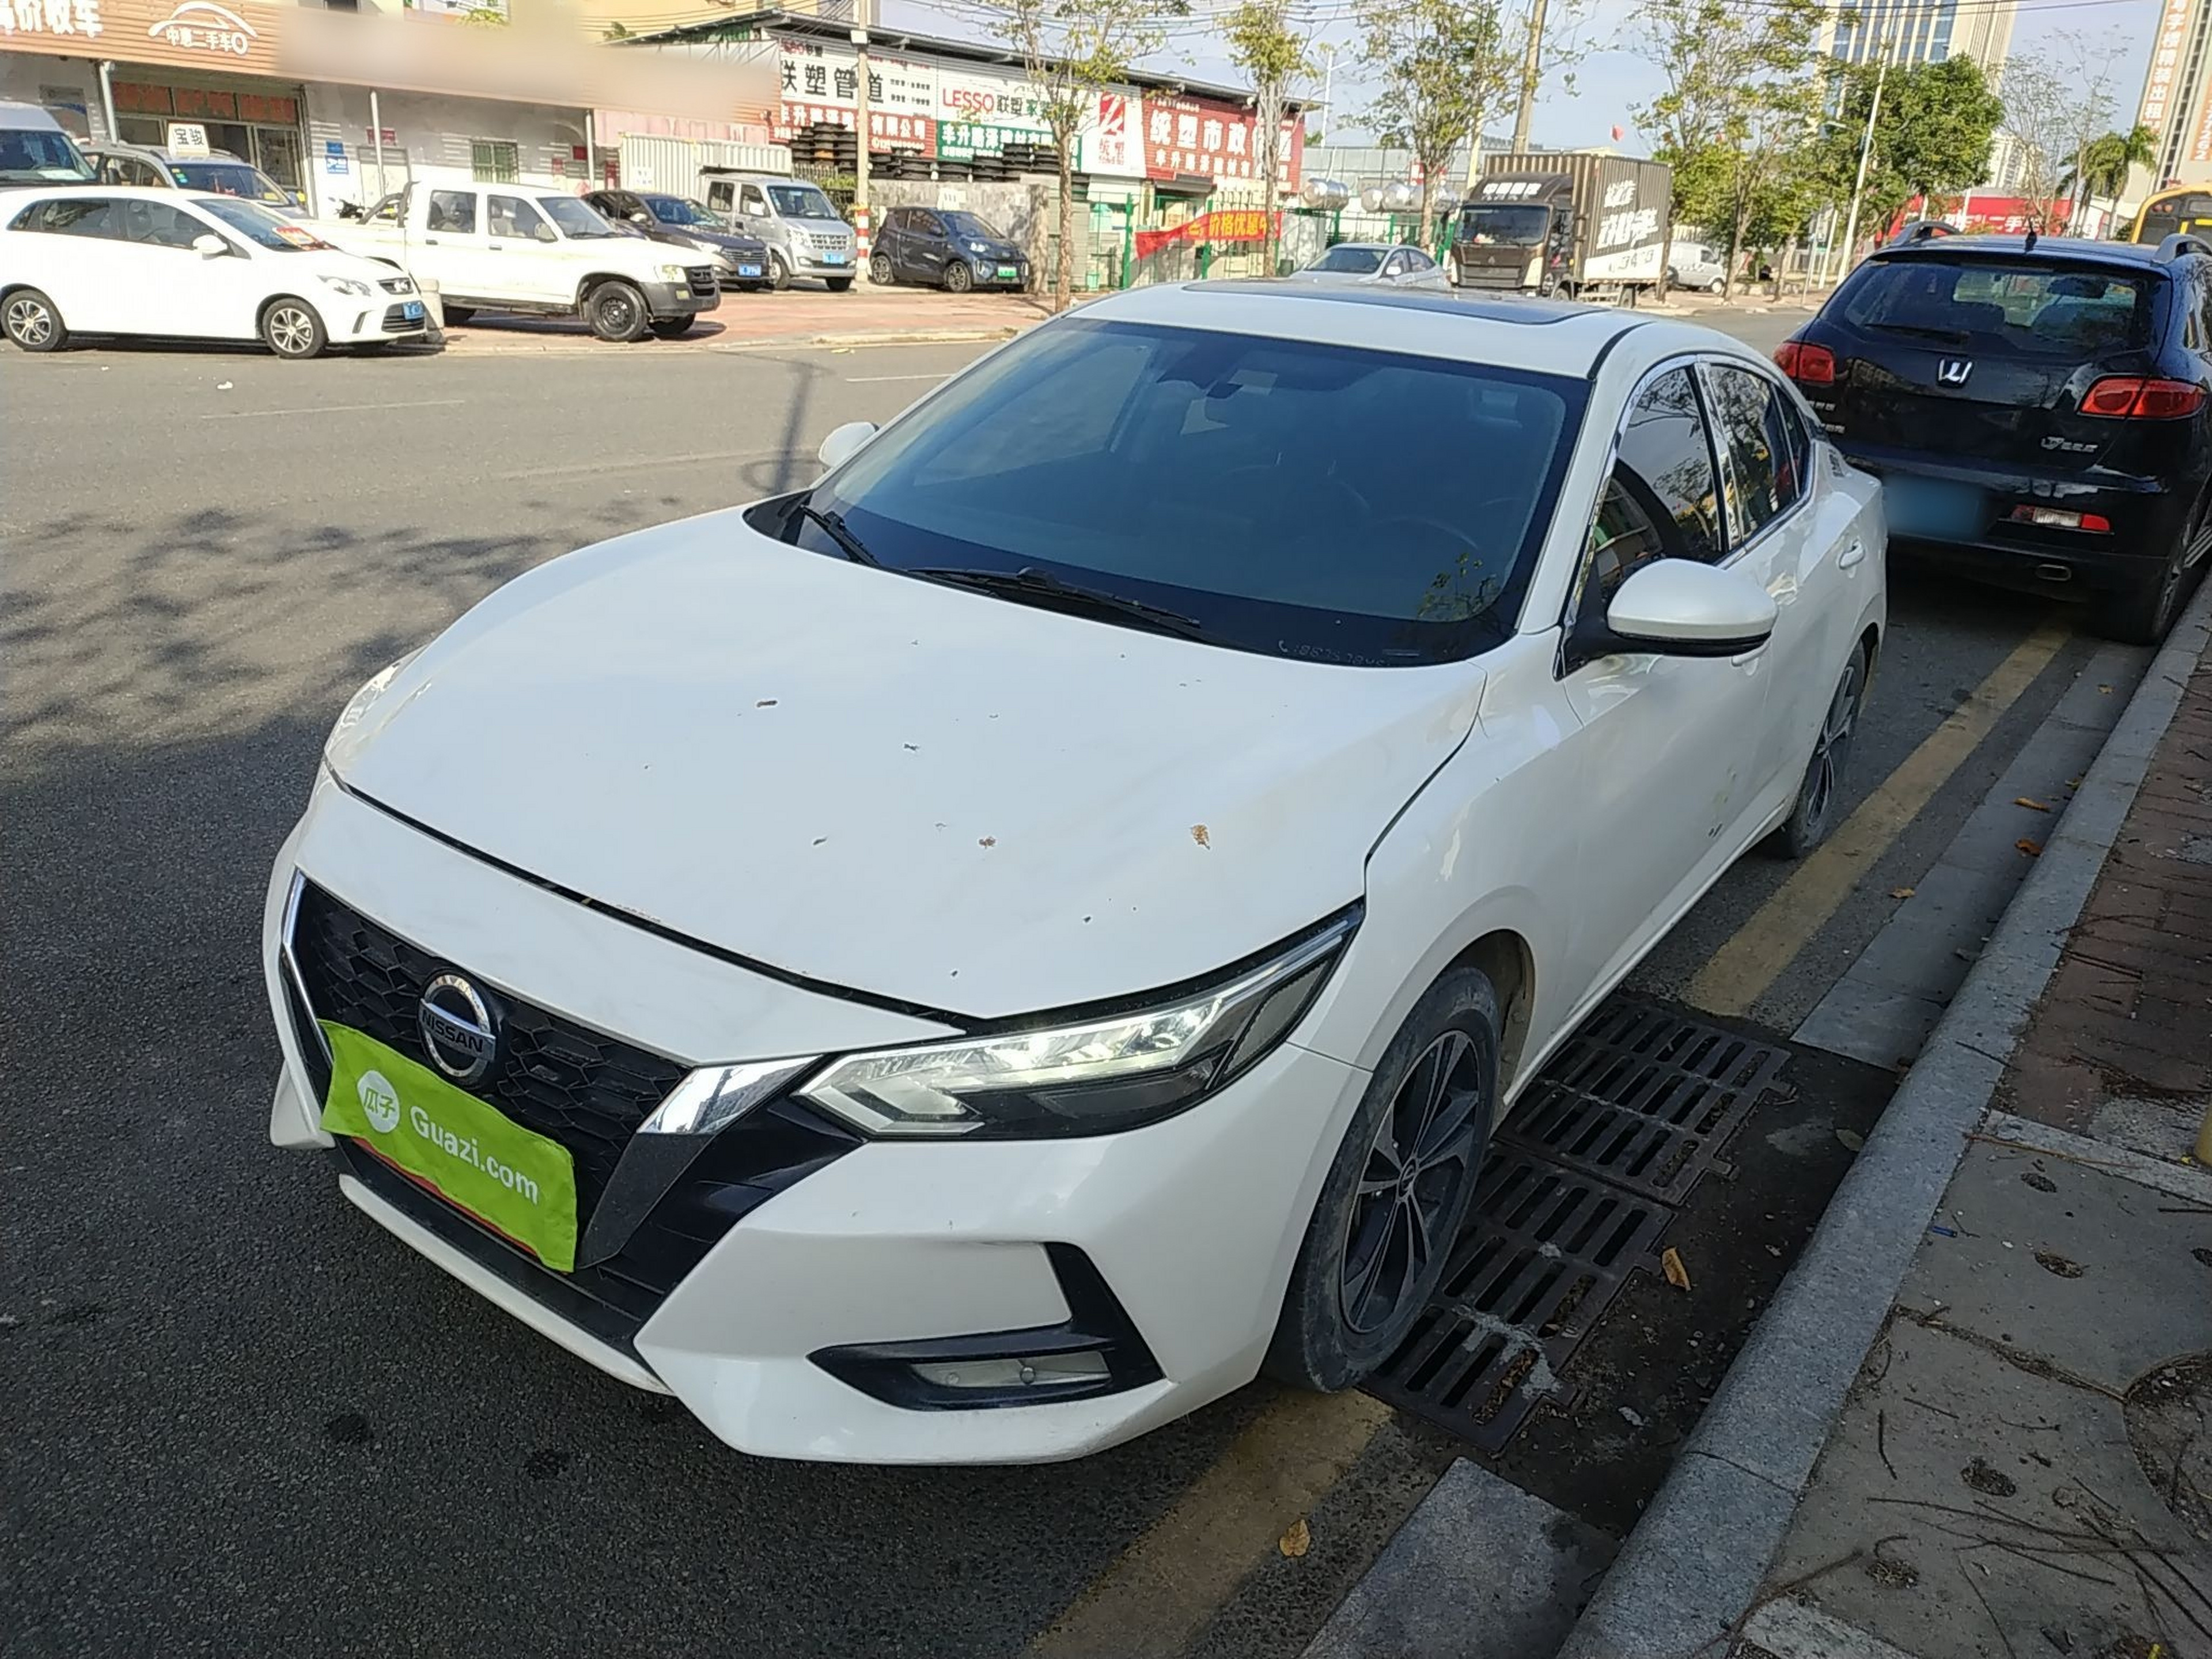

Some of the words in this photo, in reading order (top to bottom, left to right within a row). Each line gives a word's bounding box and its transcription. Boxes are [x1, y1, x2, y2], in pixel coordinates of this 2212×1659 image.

[2142, 0, 2187, 132] 写字楼精装出租
[942, 88, 994, 114] LESSO
[422, 1010, 484, 1053] NISSAN
[363, 1087, 396, 1119] 瓜子
[410, 1105, 539, 1206] Guazi.com
